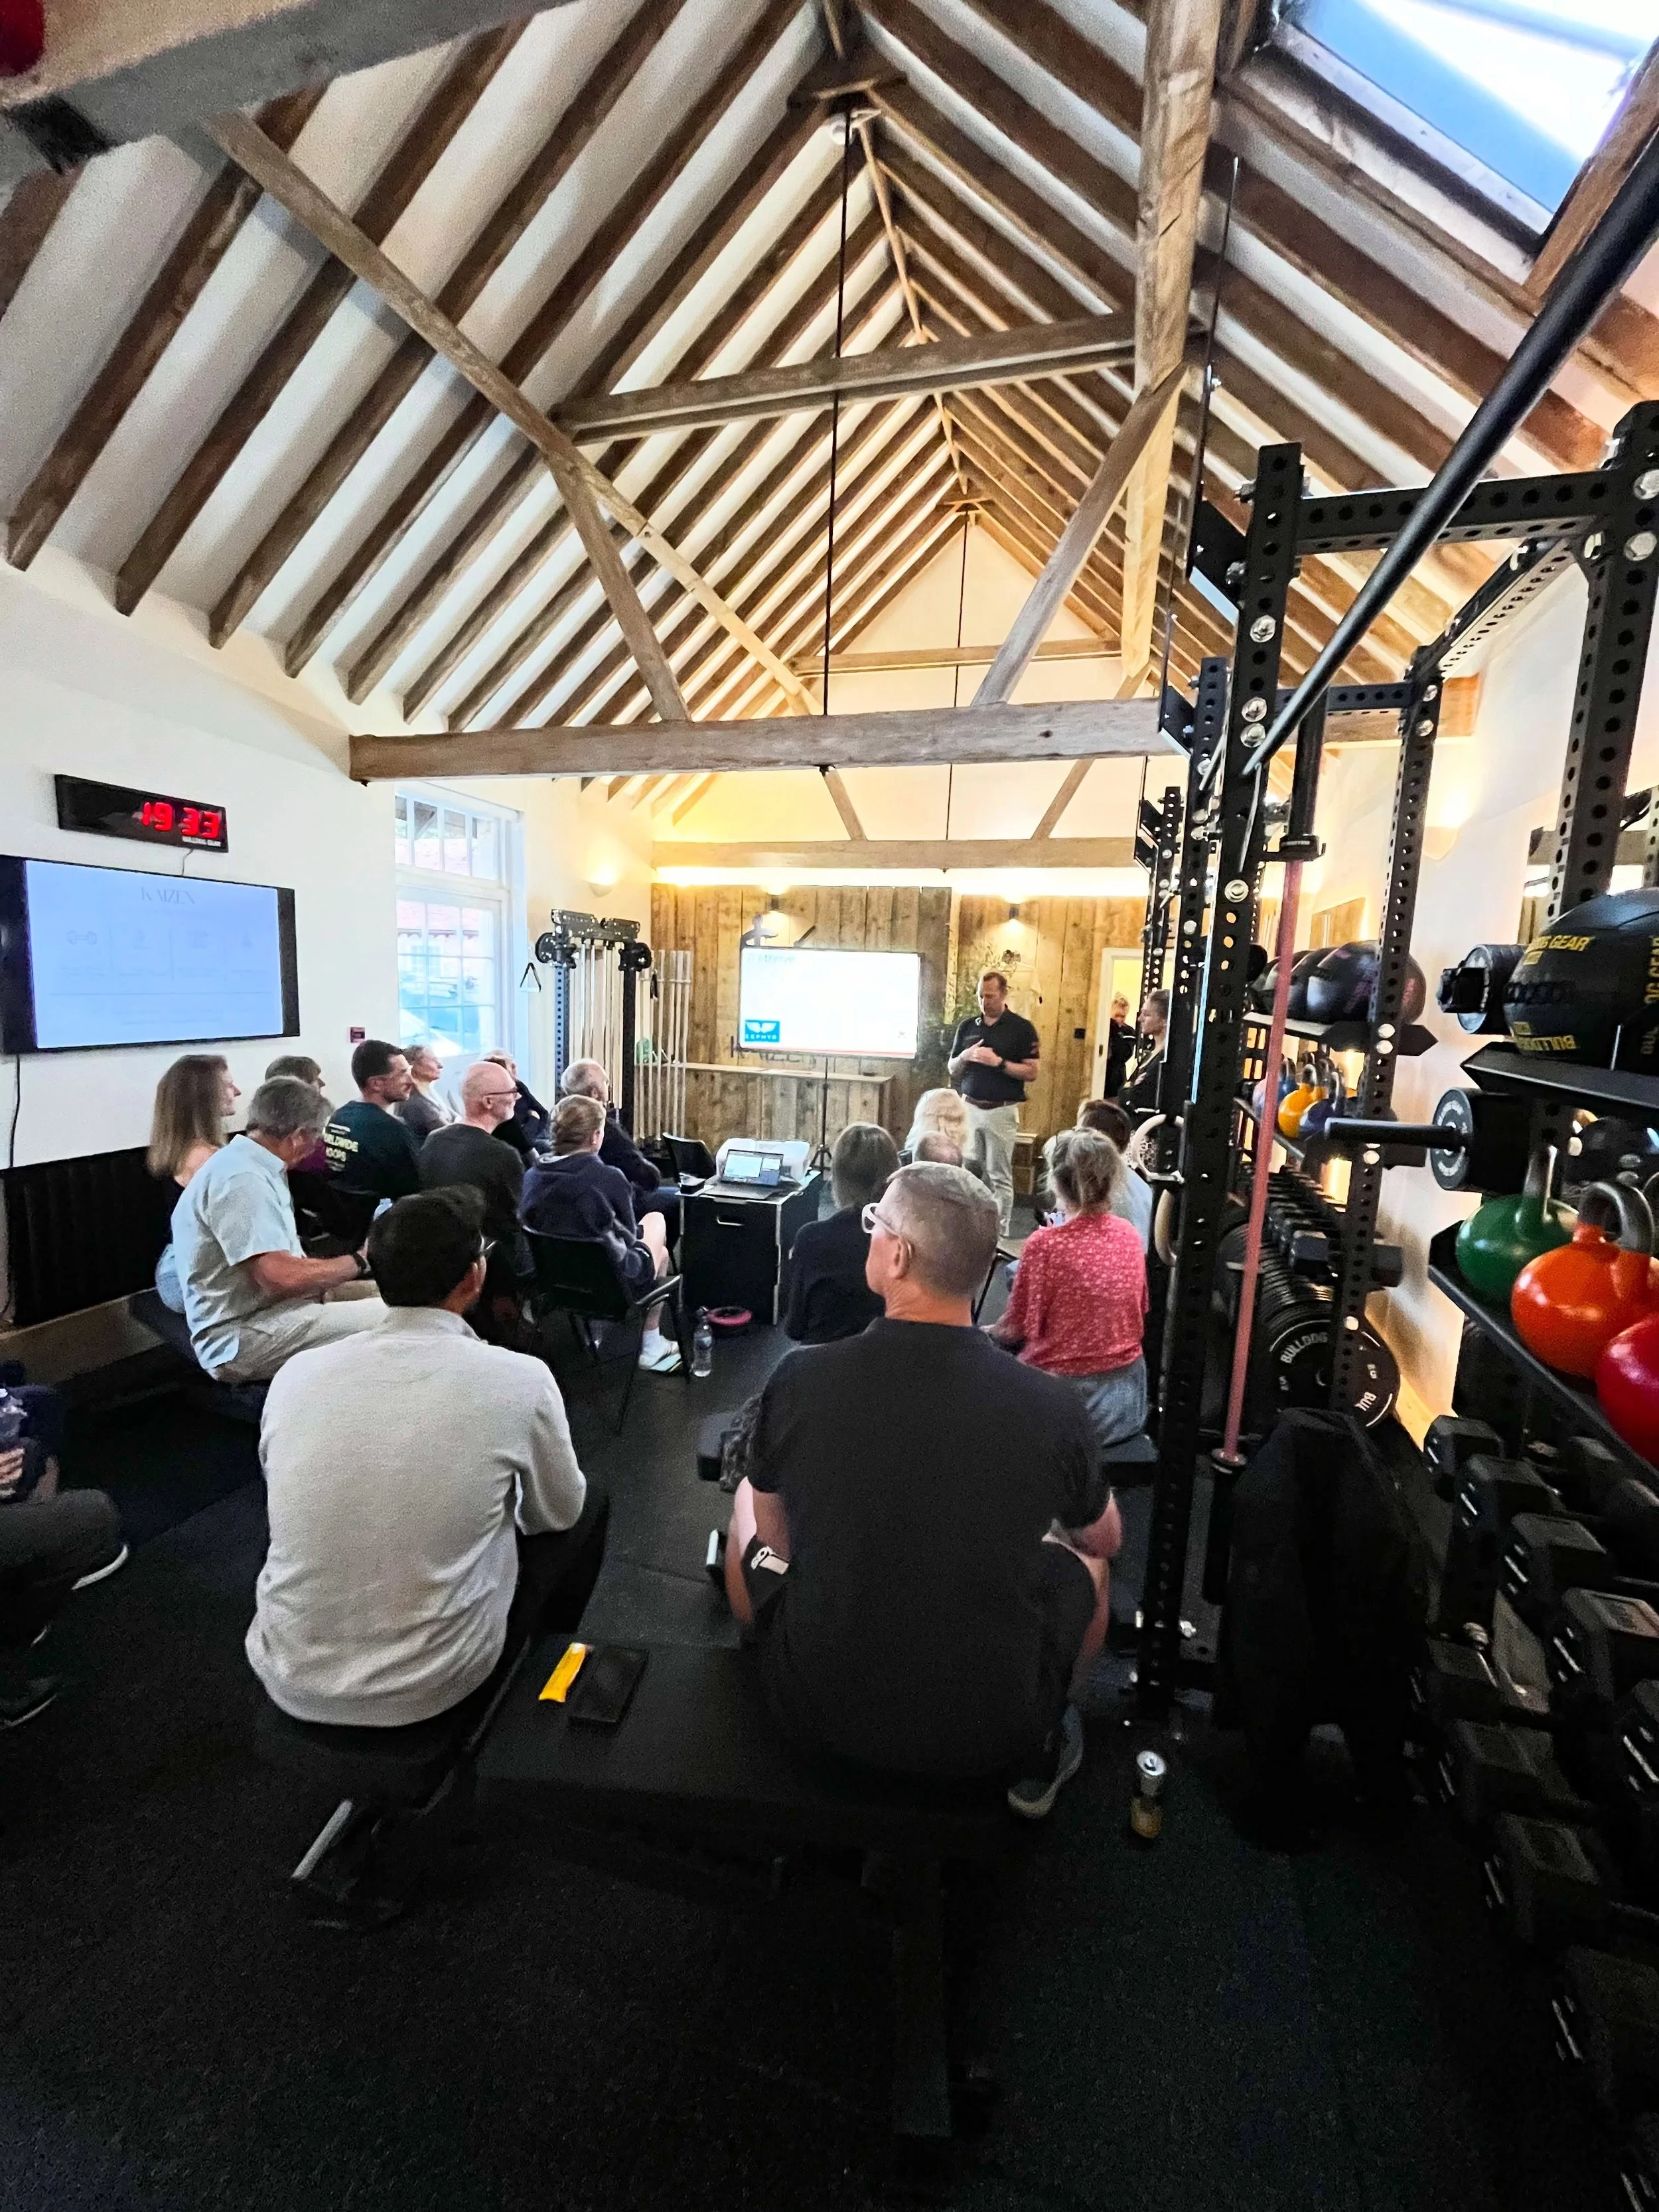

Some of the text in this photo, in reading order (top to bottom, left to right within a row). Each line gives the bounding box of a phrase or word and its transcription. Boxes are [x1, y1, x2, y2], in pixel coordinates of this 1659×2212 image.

[141, 886, 195, 905] KAIZEN
[1549, 935, 1591, 952] GEAR
[1280, 1332, 1328, 1364] BULLDOG
